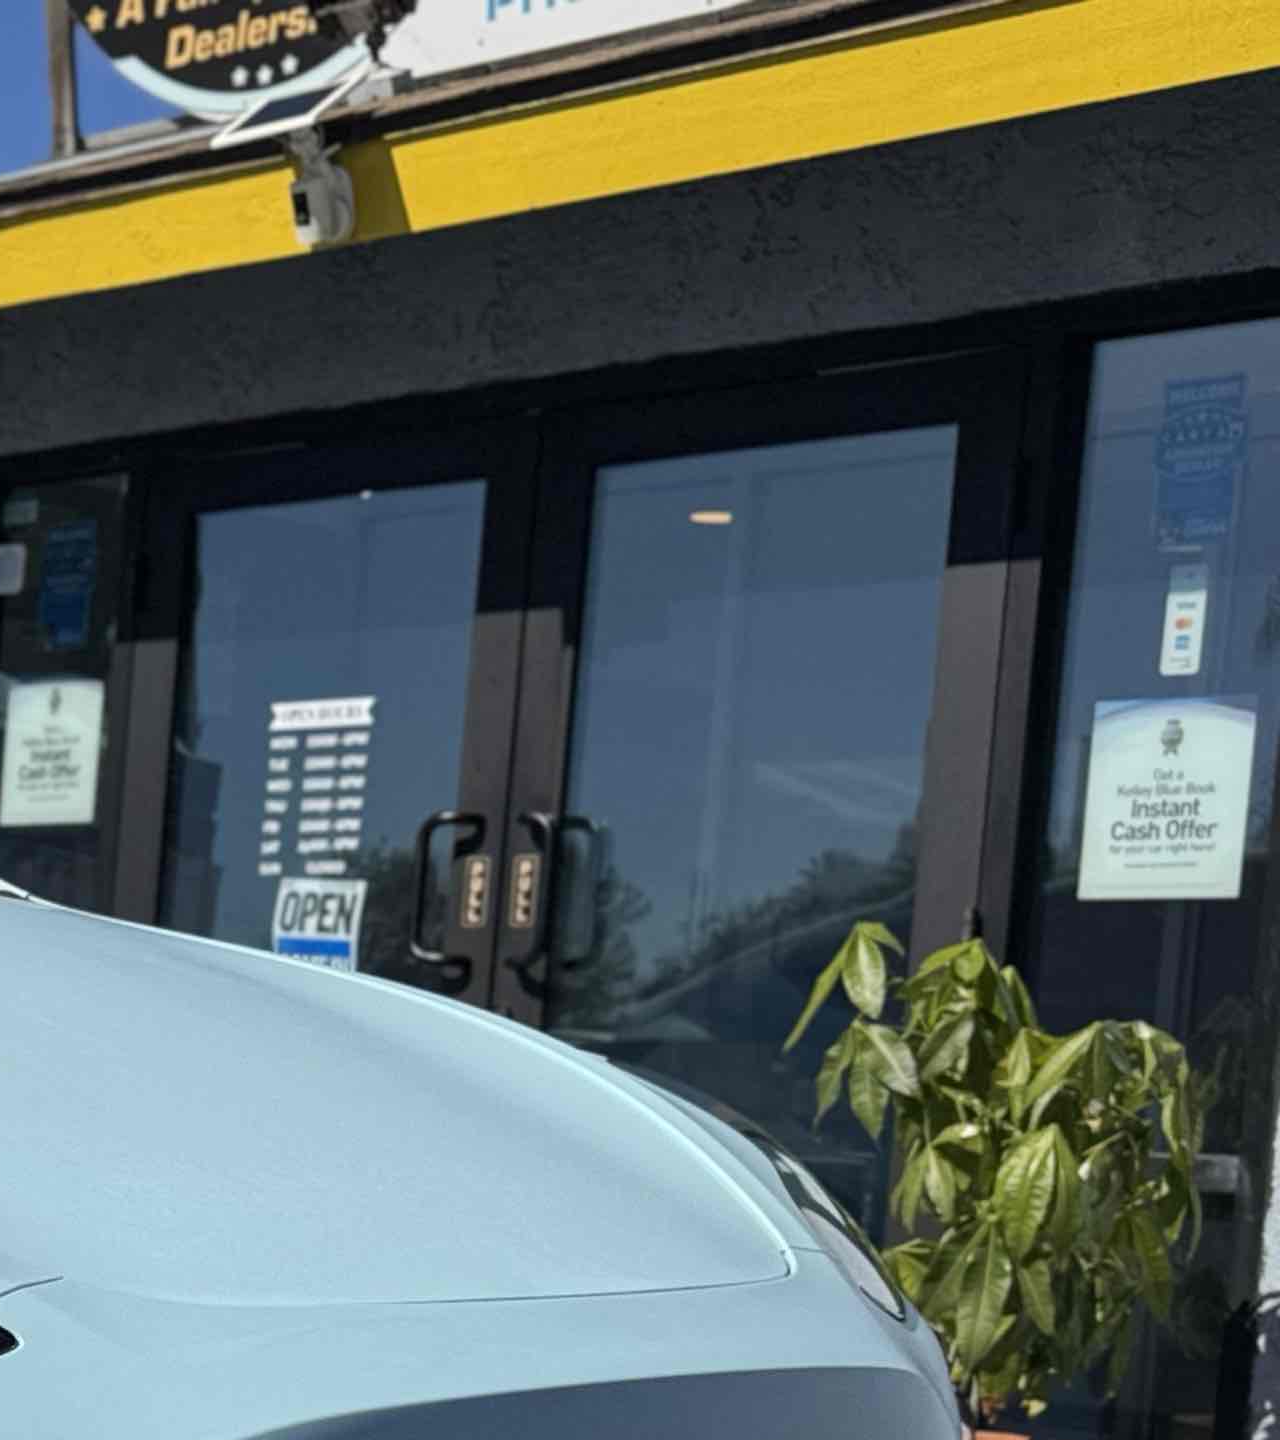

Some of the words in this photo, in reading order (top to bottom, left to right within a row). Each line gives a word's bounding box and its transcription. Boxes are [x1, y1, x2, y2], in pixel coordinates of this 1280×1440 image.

[164, 5, 318, 69] Dealers.
[1131, 798, 1201, 818] Instant
[1111, 820, 1160, 841] Cash
[1166, 819, 1218, 840] Offer
[279, 890, 359, 935] OPEN
